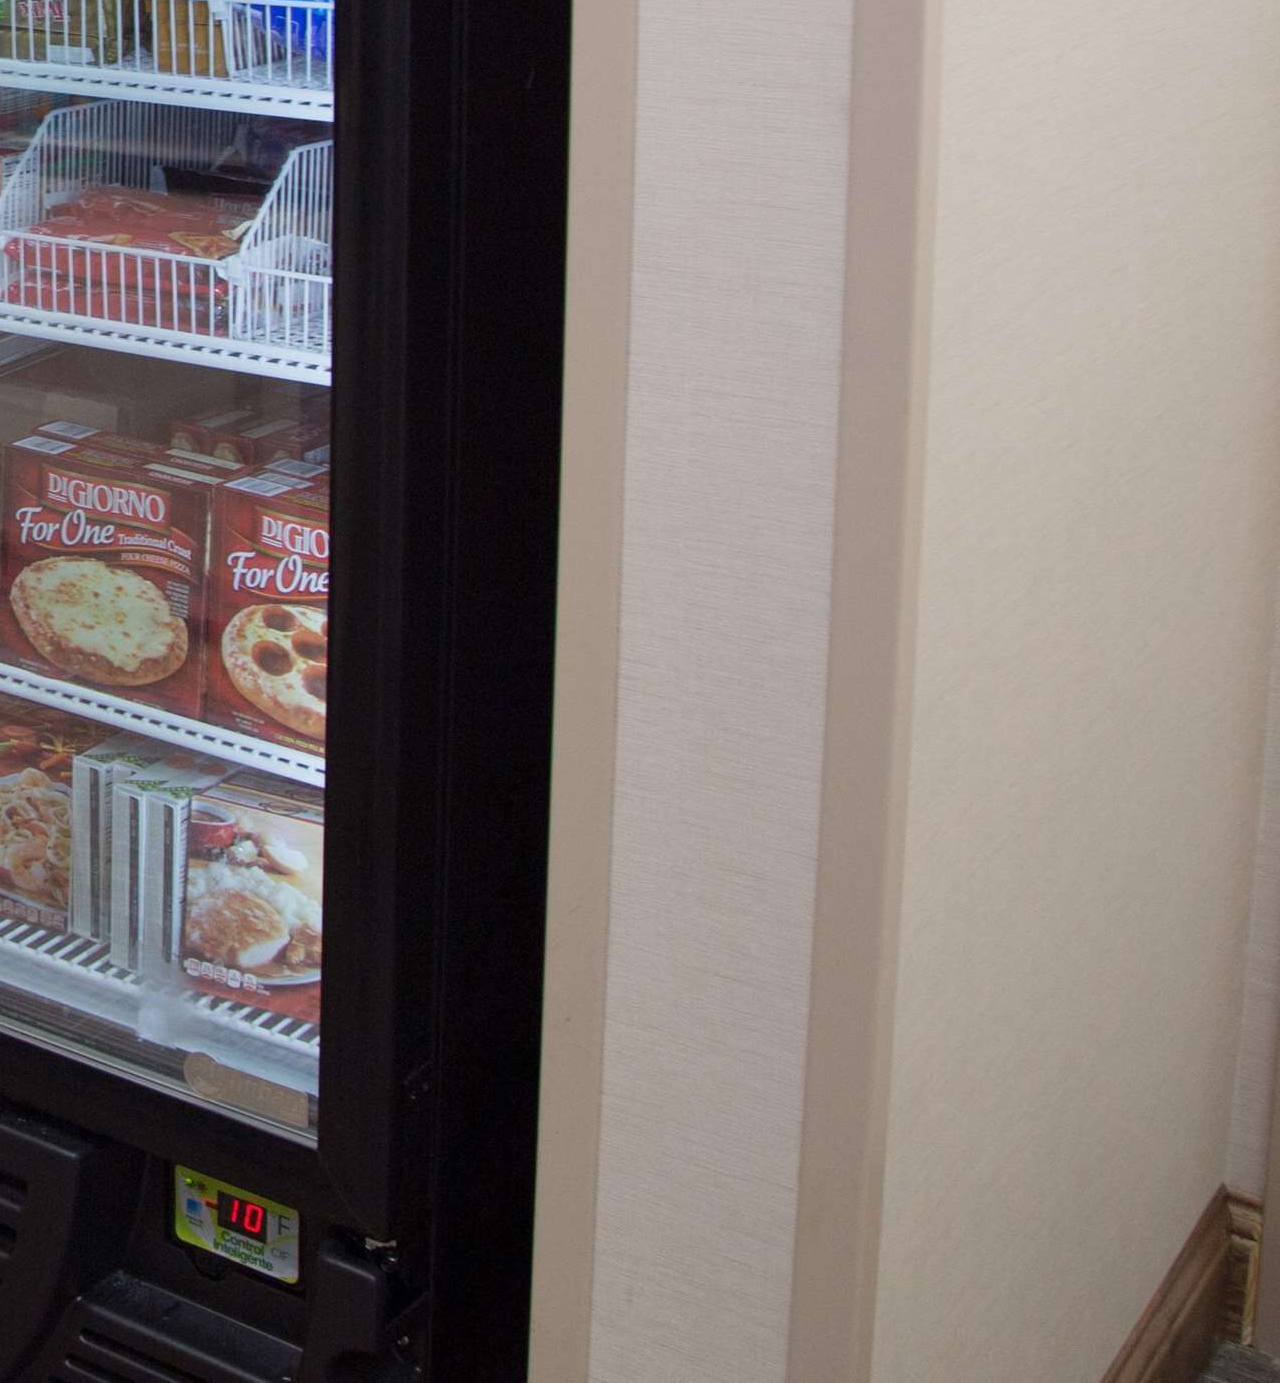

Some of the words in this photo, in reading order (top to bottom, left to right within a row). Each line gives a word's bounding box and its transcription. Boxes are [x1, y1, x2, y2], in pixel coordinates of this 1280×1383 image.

[16, 506, 60, 544] For
[61, 509, 114, 546] One
[261, 515, 330, 558] DIGIO
[226, 551, 274, 591] For
[275, 554, 330, 593] One
[230, 1197, 265, 1234] 10
[278, 1214, 290, 1236] F
[220, 1230, 266, 1257] Control
